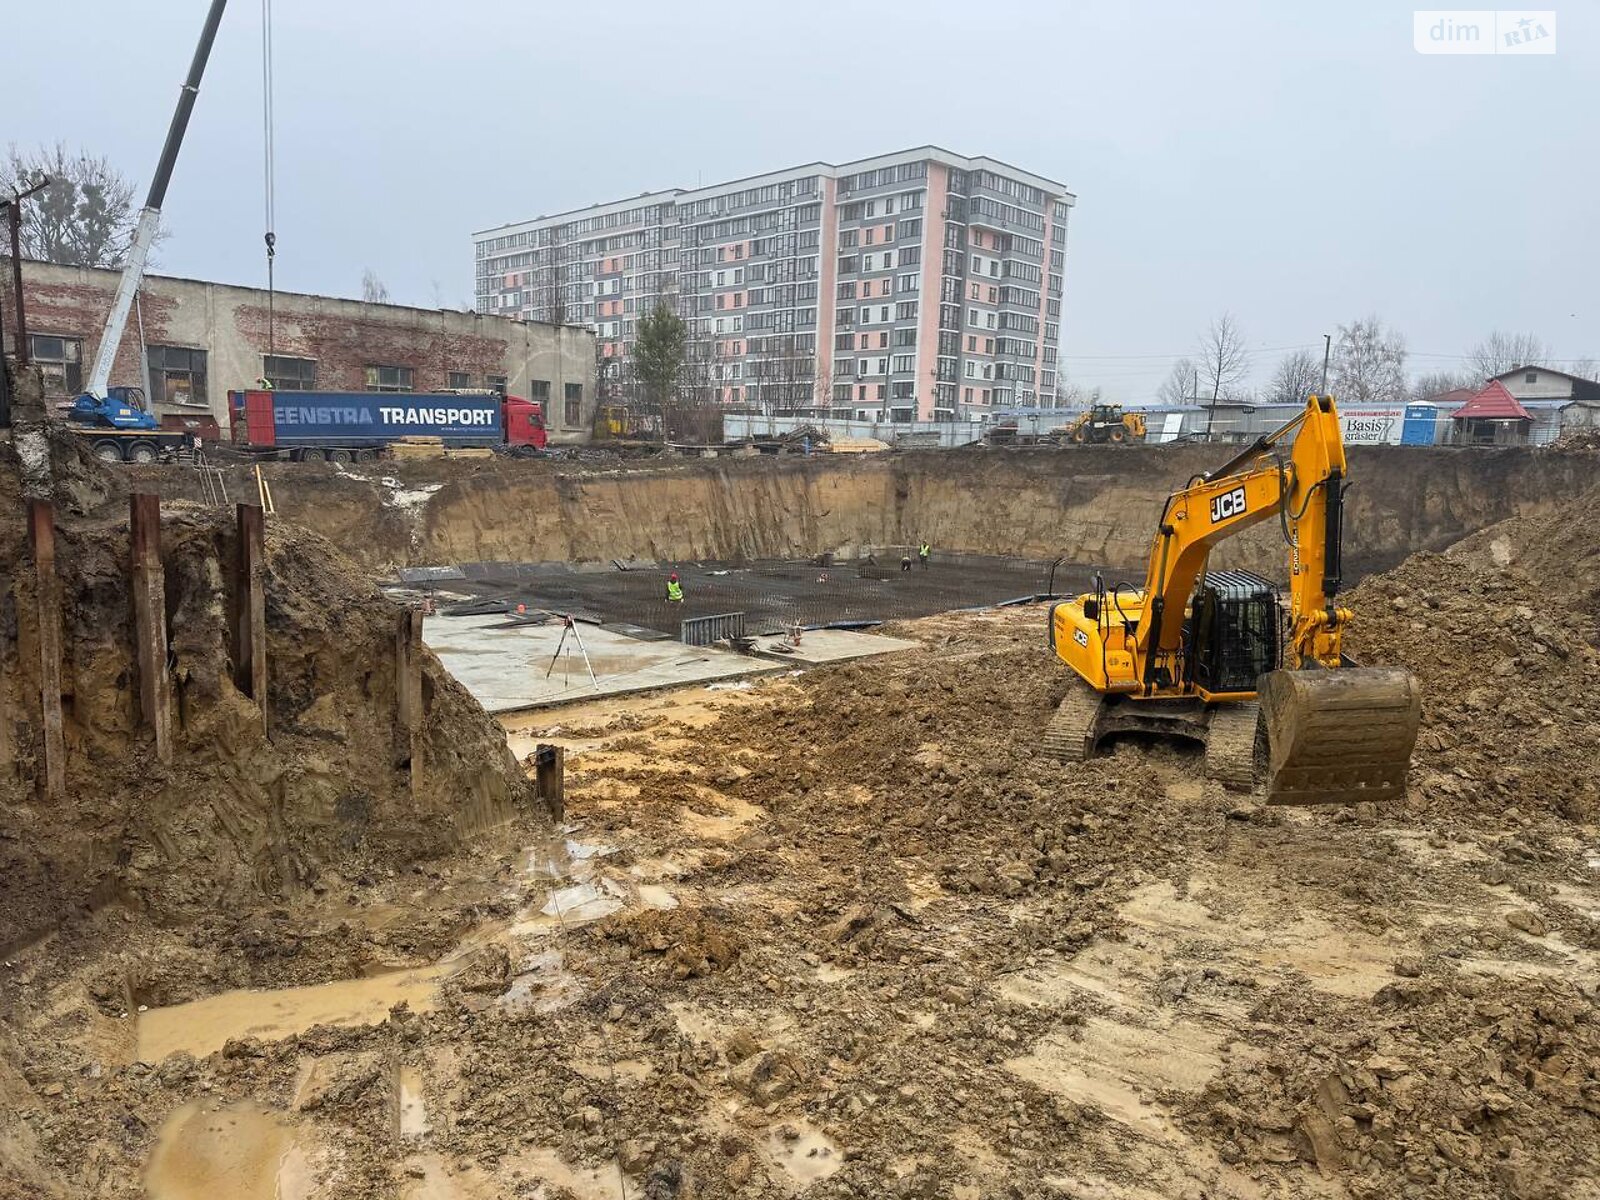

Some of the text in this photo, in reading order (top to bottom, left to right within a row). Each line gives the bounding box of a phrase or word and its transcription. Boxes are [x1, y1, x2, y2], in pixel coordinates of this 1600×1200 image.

[379, 407, 495, 425] TRANSPORT
[1347, 418, 1382, 432] Basis
[1210, 486, 1247, 523] JCB
[1073, 627, 1089, 649] JCB
